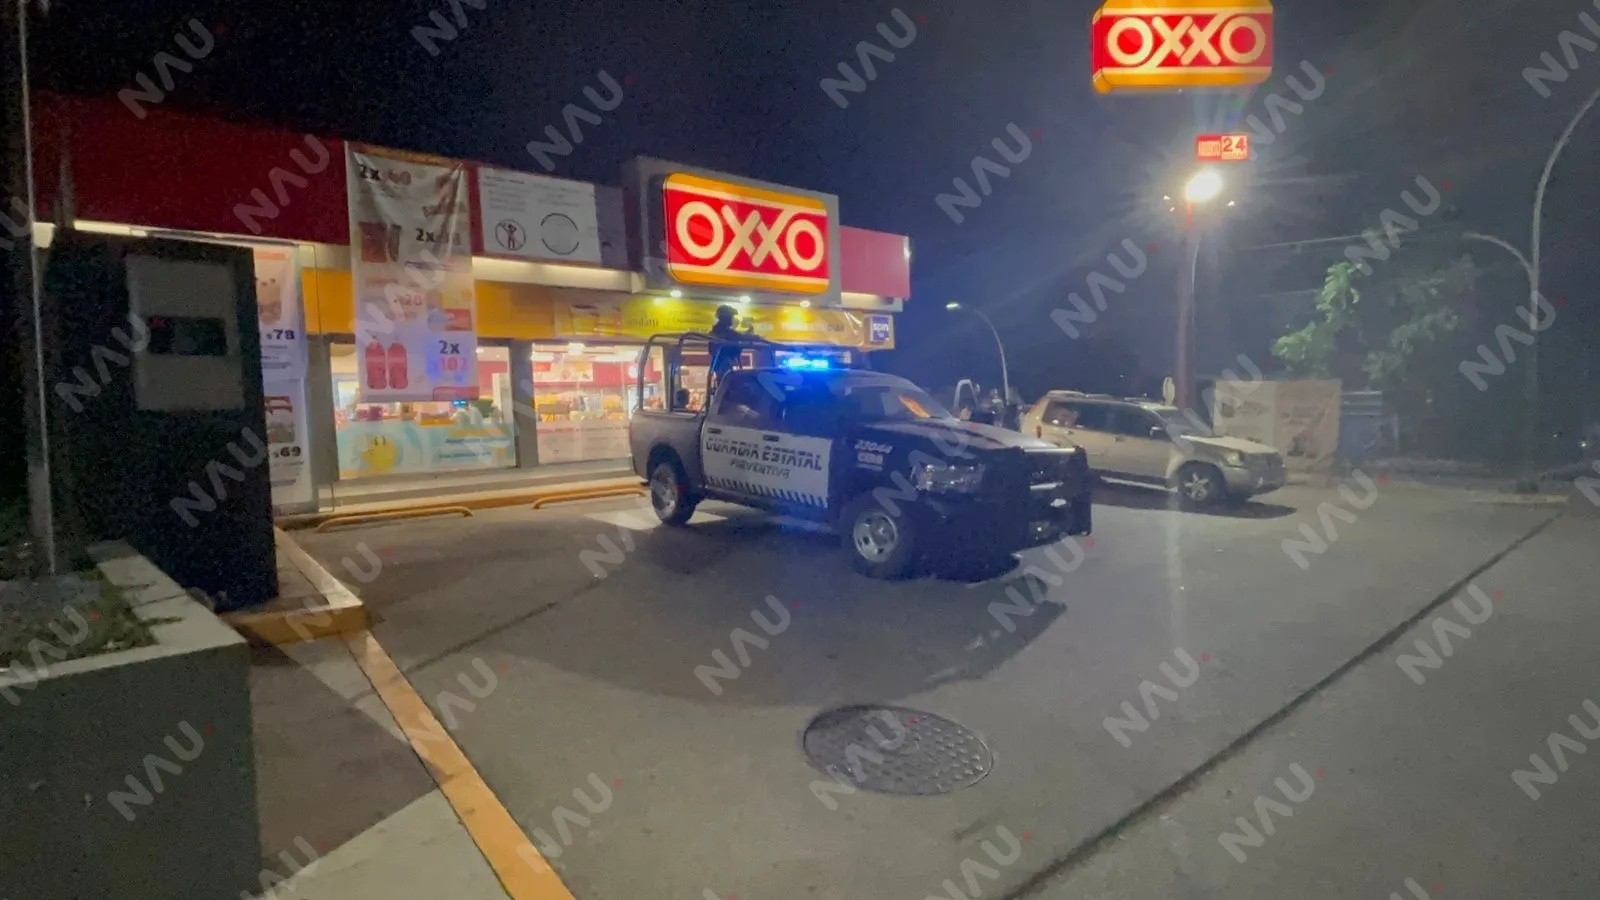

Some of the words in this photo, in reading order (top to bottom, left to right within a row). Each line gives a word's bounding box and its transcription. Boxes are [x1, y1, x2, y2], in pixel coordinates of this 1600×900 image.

[1106, 13, 1267, 70] OXXO
[1221, 136, 1247, 153] 24
[675, 200, 825, 272] OXXO
[438, 340, 461, 355] 2x
